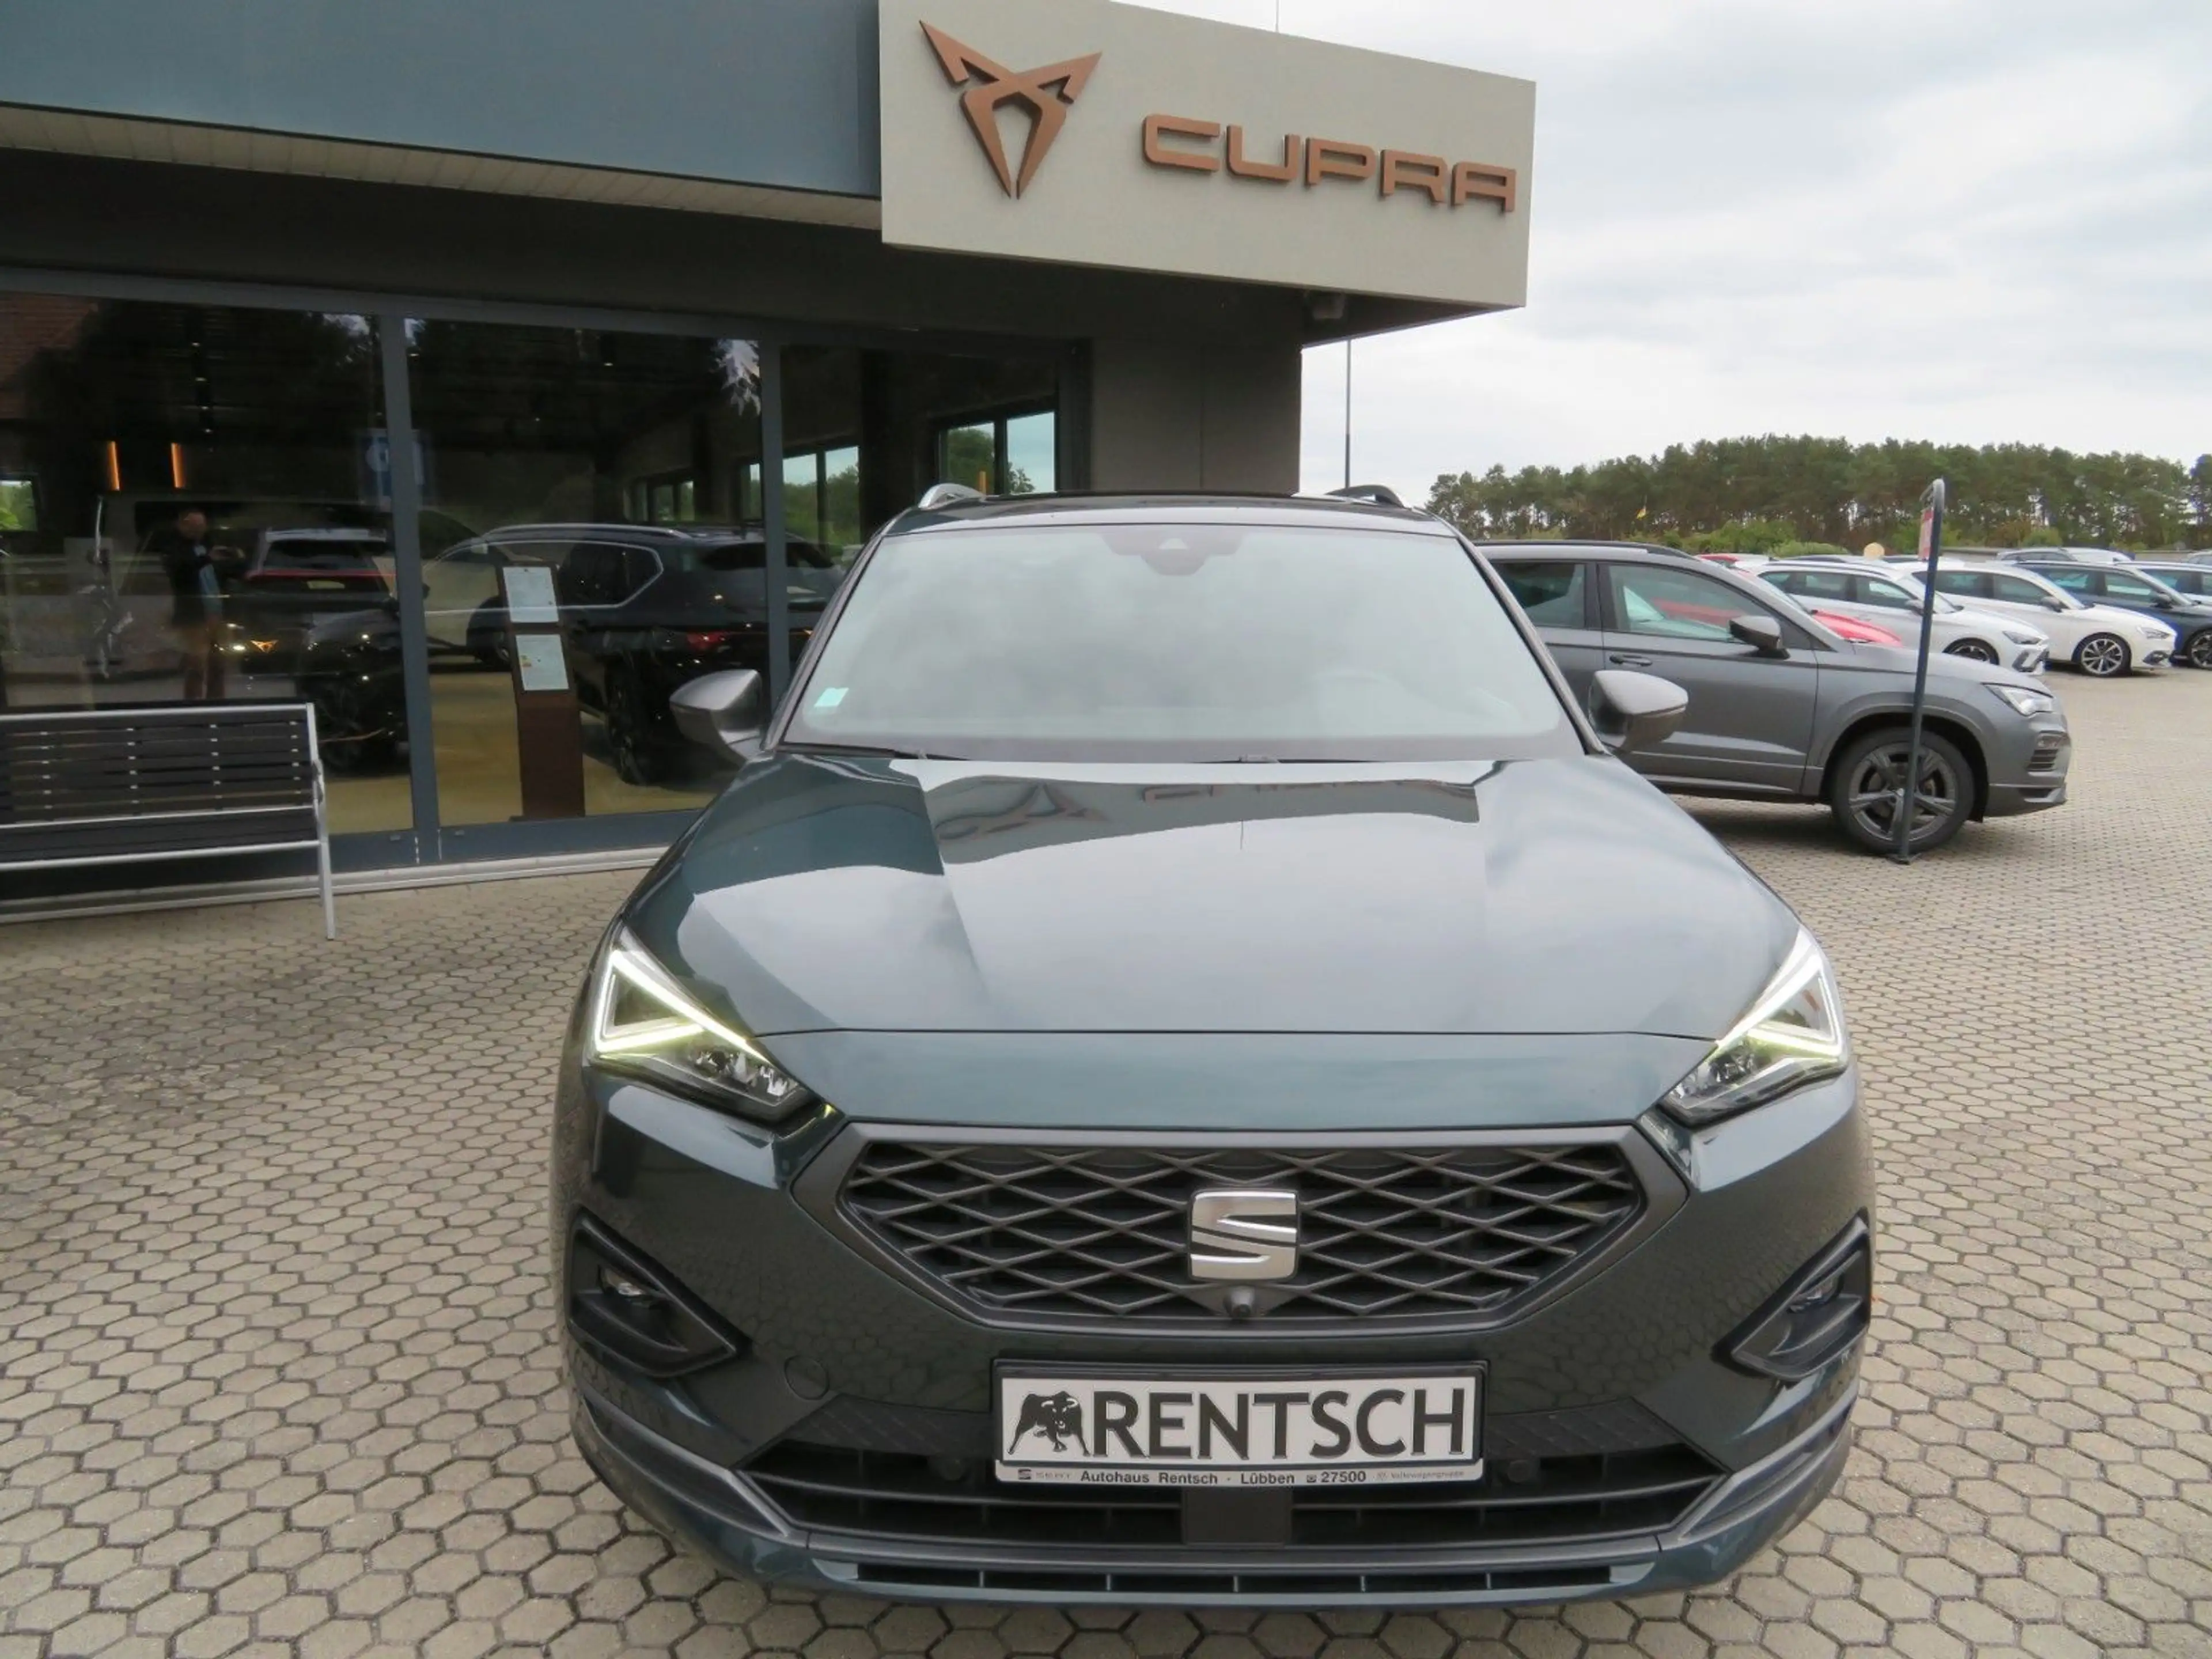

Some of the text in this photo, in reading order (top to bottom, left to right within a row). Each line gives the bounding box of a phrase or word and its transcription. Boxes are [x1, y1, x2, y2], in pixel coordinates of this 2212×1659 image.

[1142, 115, 1516, 213] CUPRA
[1093, 1388, 1464, 1459] RENTSCH
[1081, 1471, 1150, 1483] Autohaus
[1158, 1472, 1218, 1484] Rentsch
[1241, 1472, 1295, 1484] Lübben
[1320, 1471, 1366, 1483] 27500
